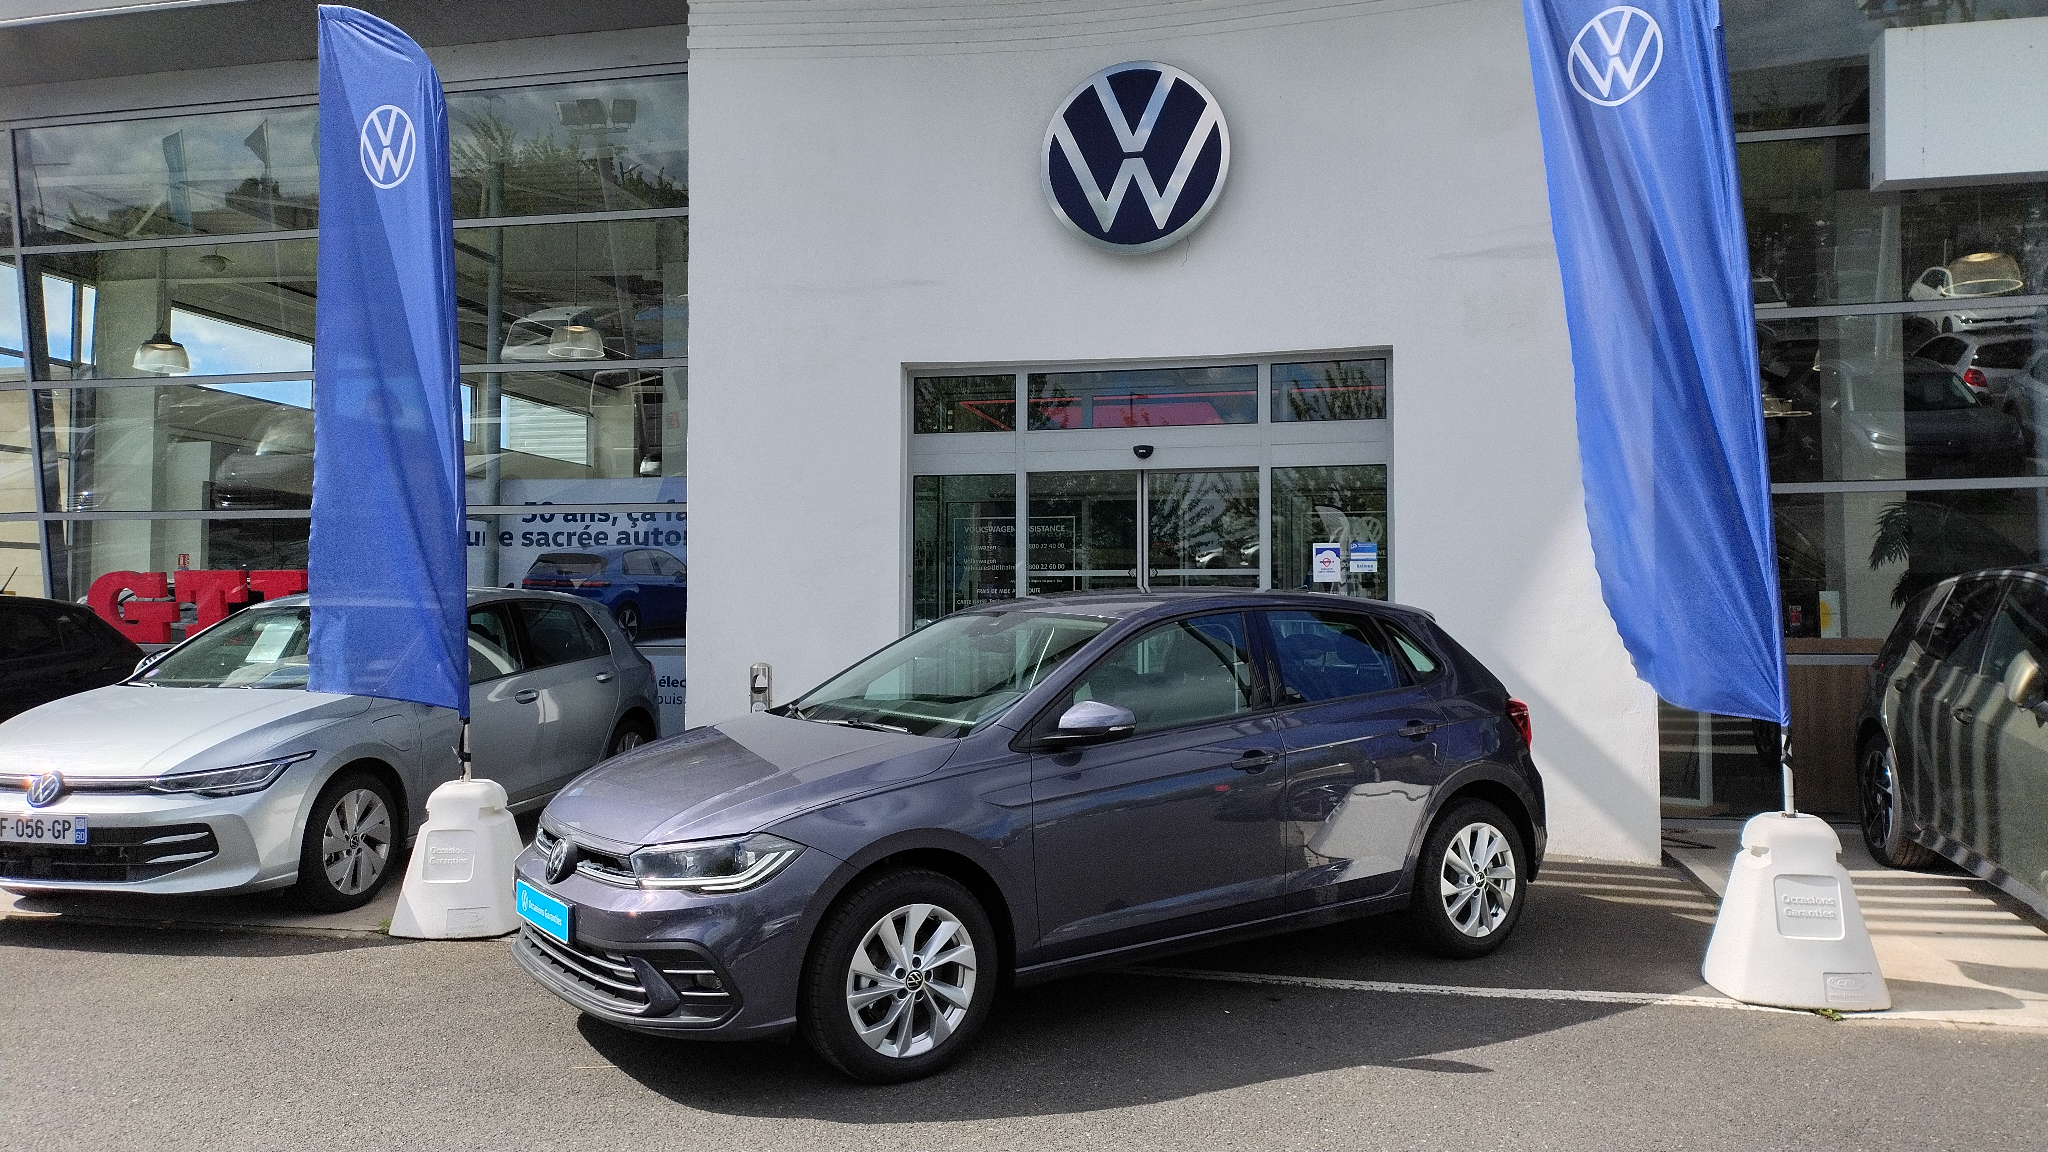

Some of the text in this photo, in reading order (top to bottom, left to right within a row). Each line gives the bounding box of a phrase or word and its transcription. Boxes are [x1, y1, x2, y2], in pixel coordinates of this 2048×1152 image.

[1568, 6, 1663, 106] VW
[361, 105, 416, 189] VW
[1043, 62, 1229, 250] VW
[467, 525, 687, 547] ue sacrée auto
[1029, 524, 1066, 533] SISTANCE
[1781, 893, 1836, 906] Occasions
[1783, 906, 1837, 919] Garanties
